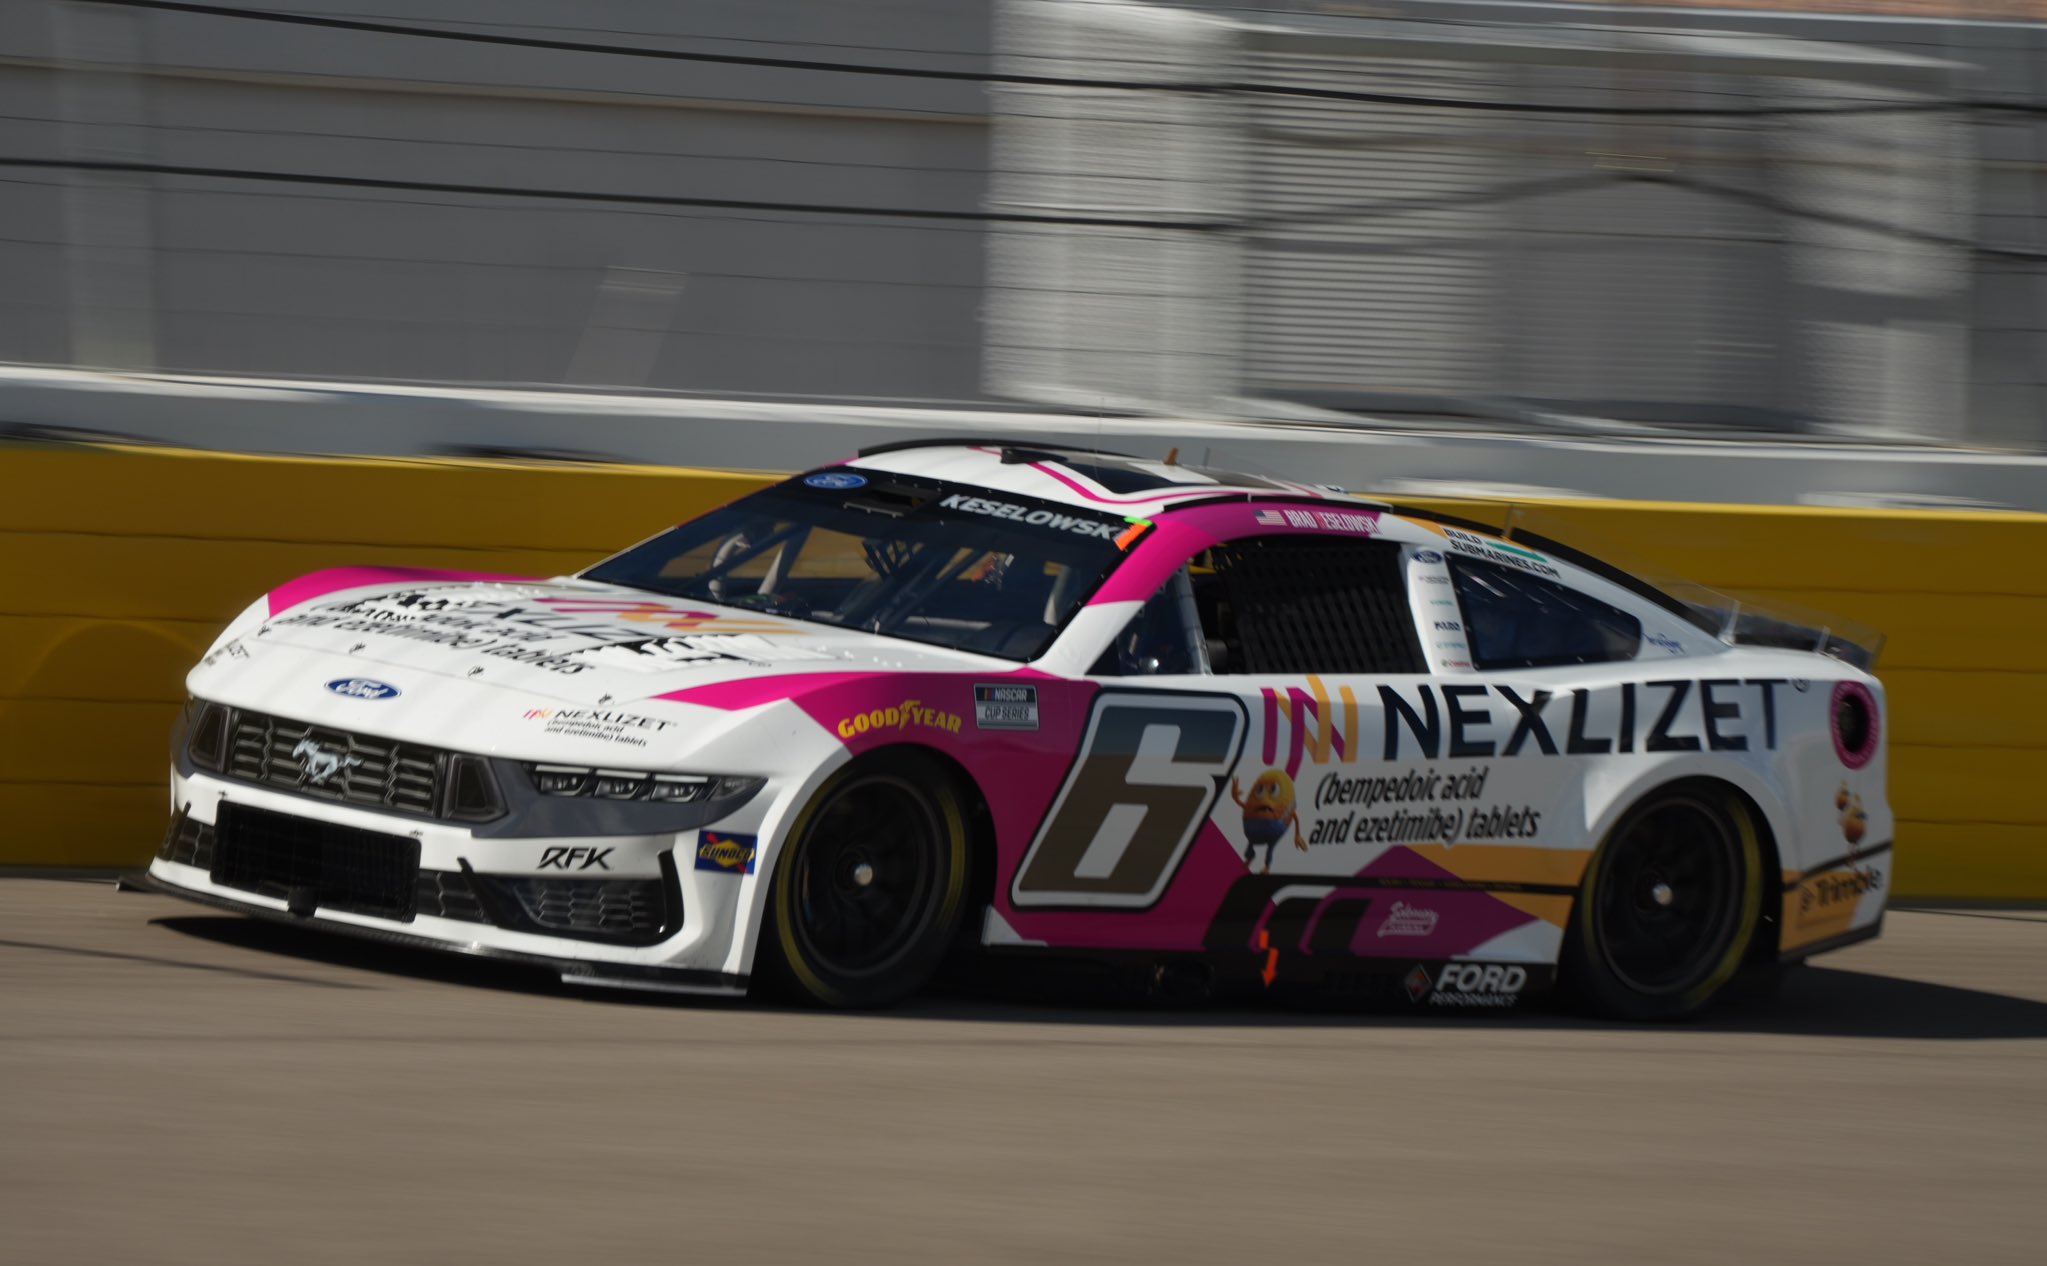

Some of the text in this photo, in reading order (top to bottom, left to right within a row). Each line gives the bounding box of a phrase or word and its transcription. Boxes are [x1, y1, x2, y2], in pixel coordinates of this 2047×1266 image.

[1284, 509, 1319, 528] BRAD
[1443, 528, 1482, 544] BUILD
[1450, 539, 1562, 578] SUBMARINES.COM
[334, 678, 392, 699] Ford
[994, 687, 1028, 702] NASCAR
[554, 709, 673, 731] NEXLIZET
[837, 699, 963, 738] GOODYEAR
[985, 705, 1030, 721] CUP SERIES
[1377, 676, 1789, 760] NEXLIZET
[614, 734, 648, 748] tablets
[1011, 690, 1247, 908] 6
[1315, 766, 1490, 809] (bempedoic acid
[1309, 805, 1541, 846] and ezetimibe) tablets
[537, 846, 615, 870] RFK
[699, 844, 755, 863] SUNOCO
[1434, 963, 1528, 993] FORD
